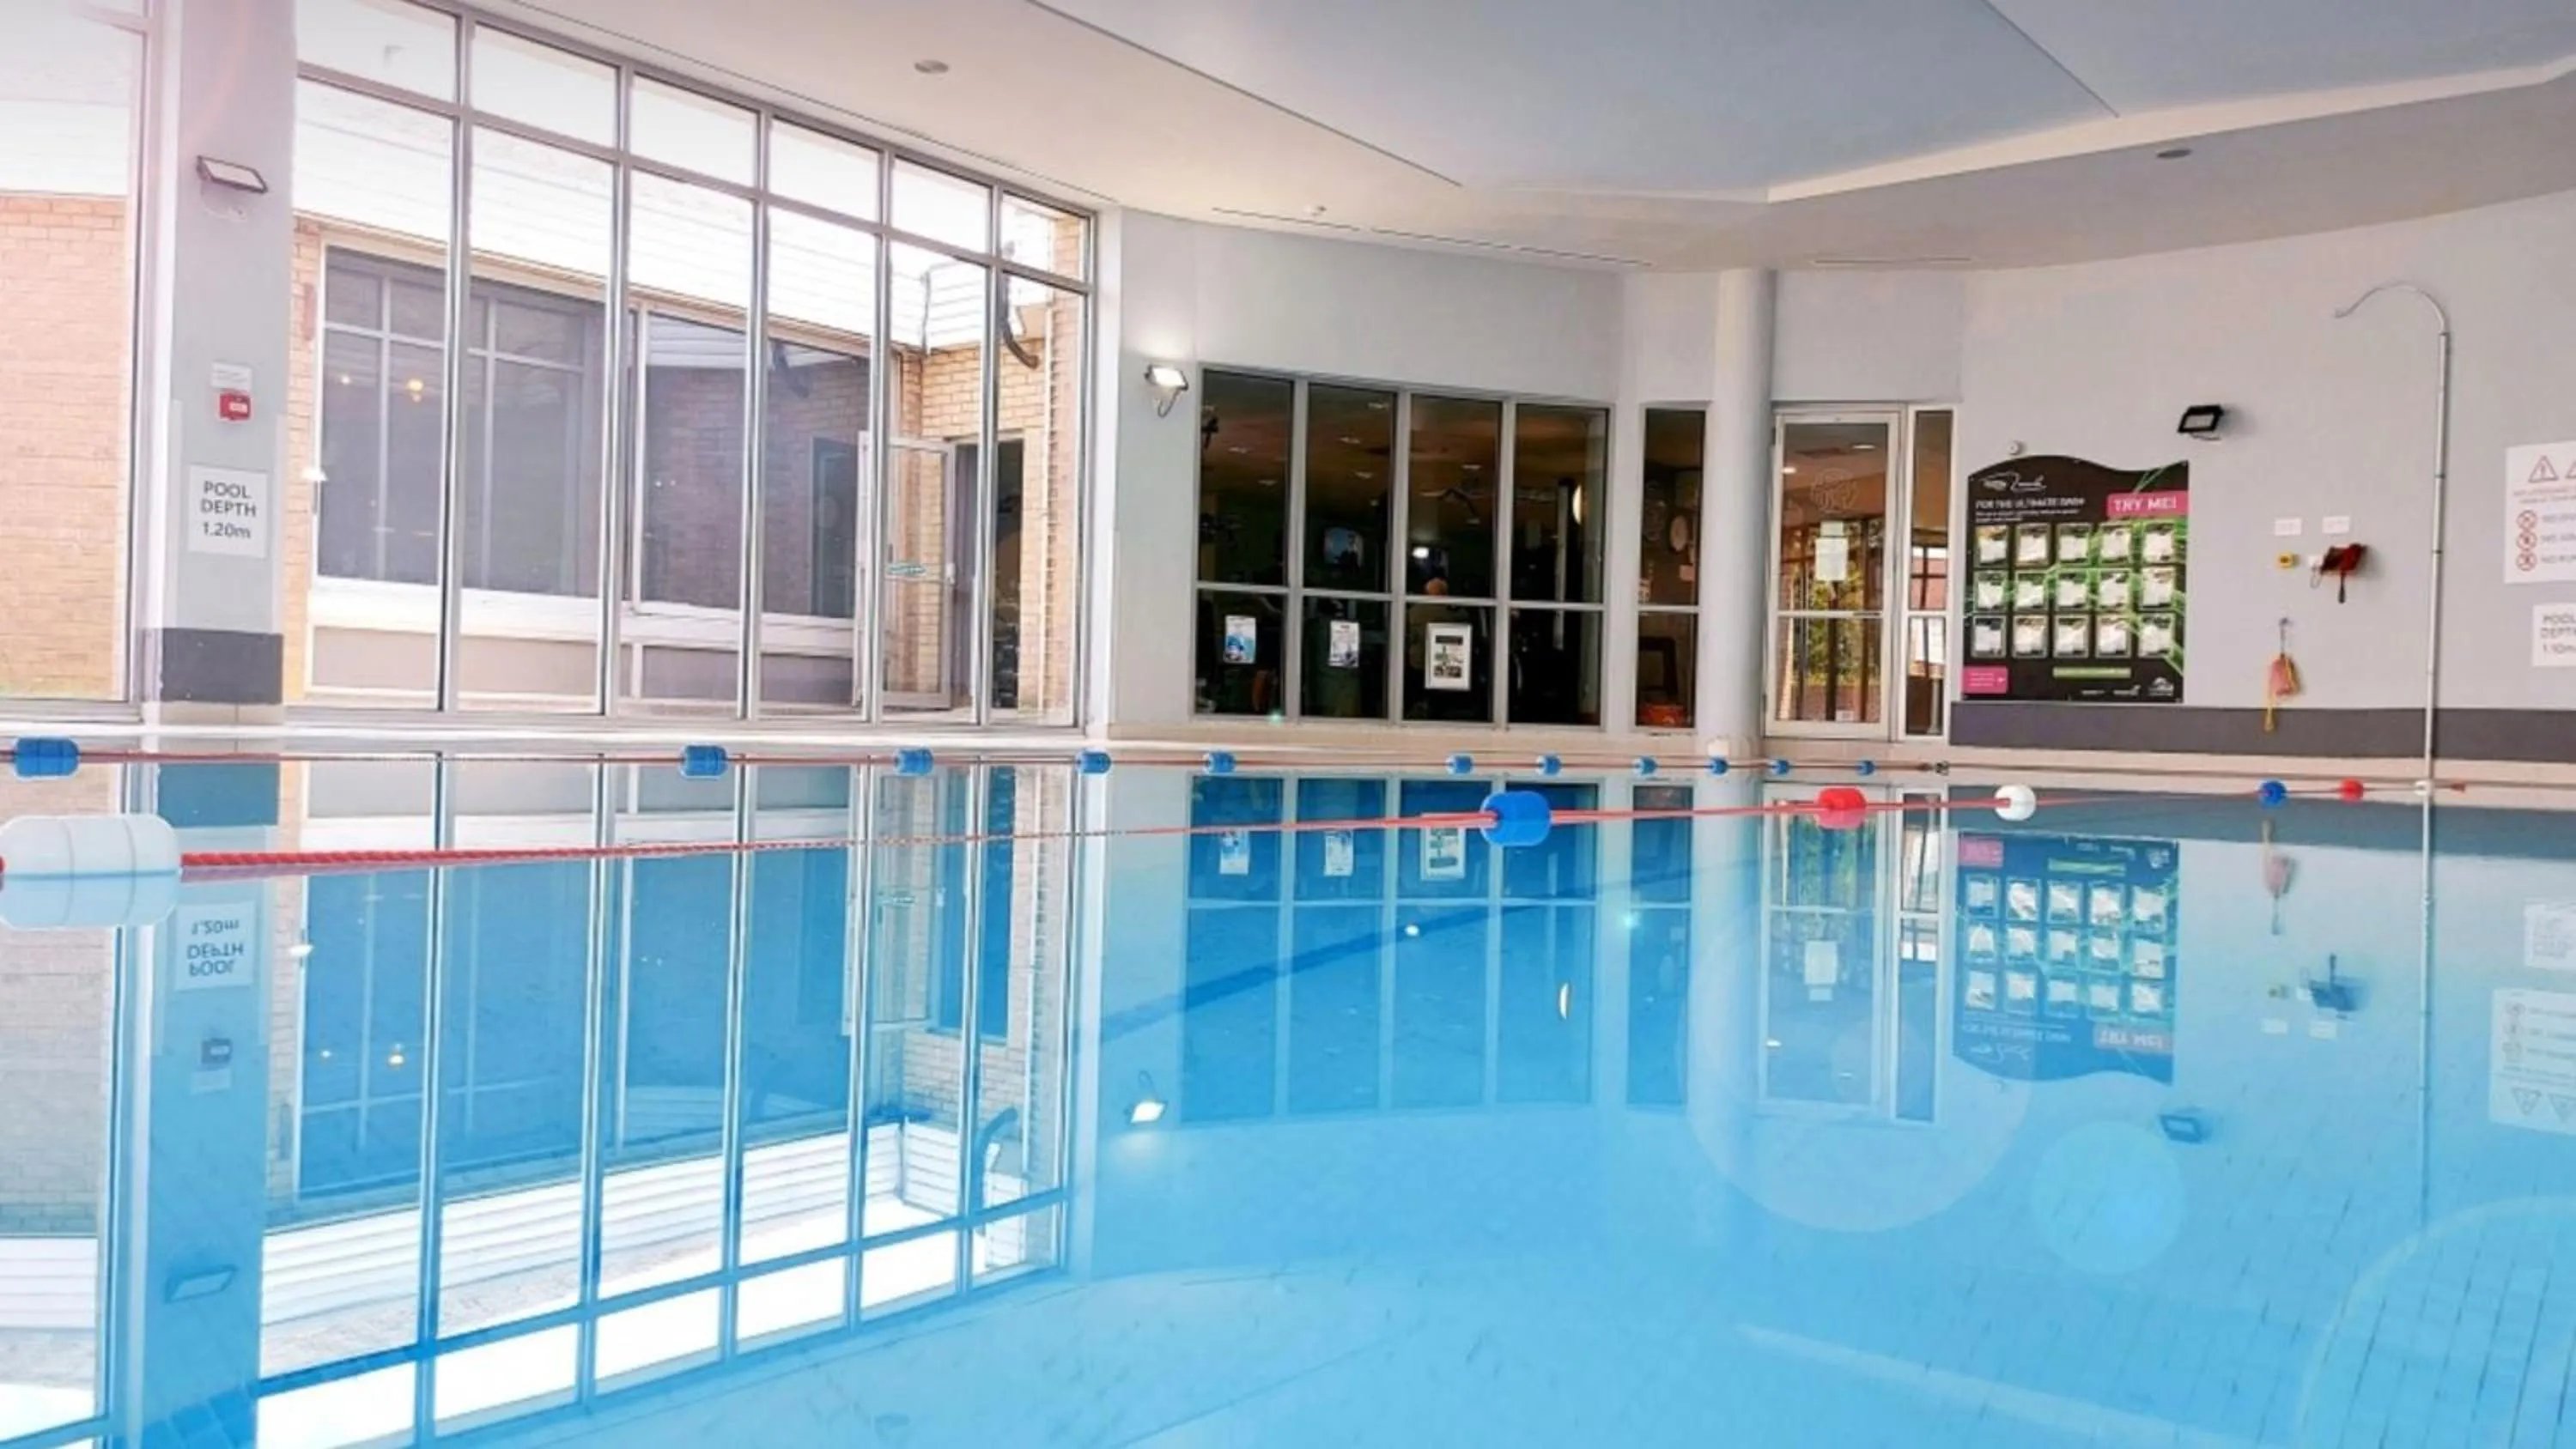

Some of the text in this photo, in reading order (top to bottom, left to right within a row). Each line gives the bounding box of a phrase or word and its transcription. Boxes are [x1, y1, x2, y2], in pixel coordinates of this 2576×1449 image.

[204, 481, 251, 499] POOL
[200, 499, 257, 517] DEPTH
[2113, 495, 2177, 512] TRY ME!
[204, 522, 251, 538] 1.20m
